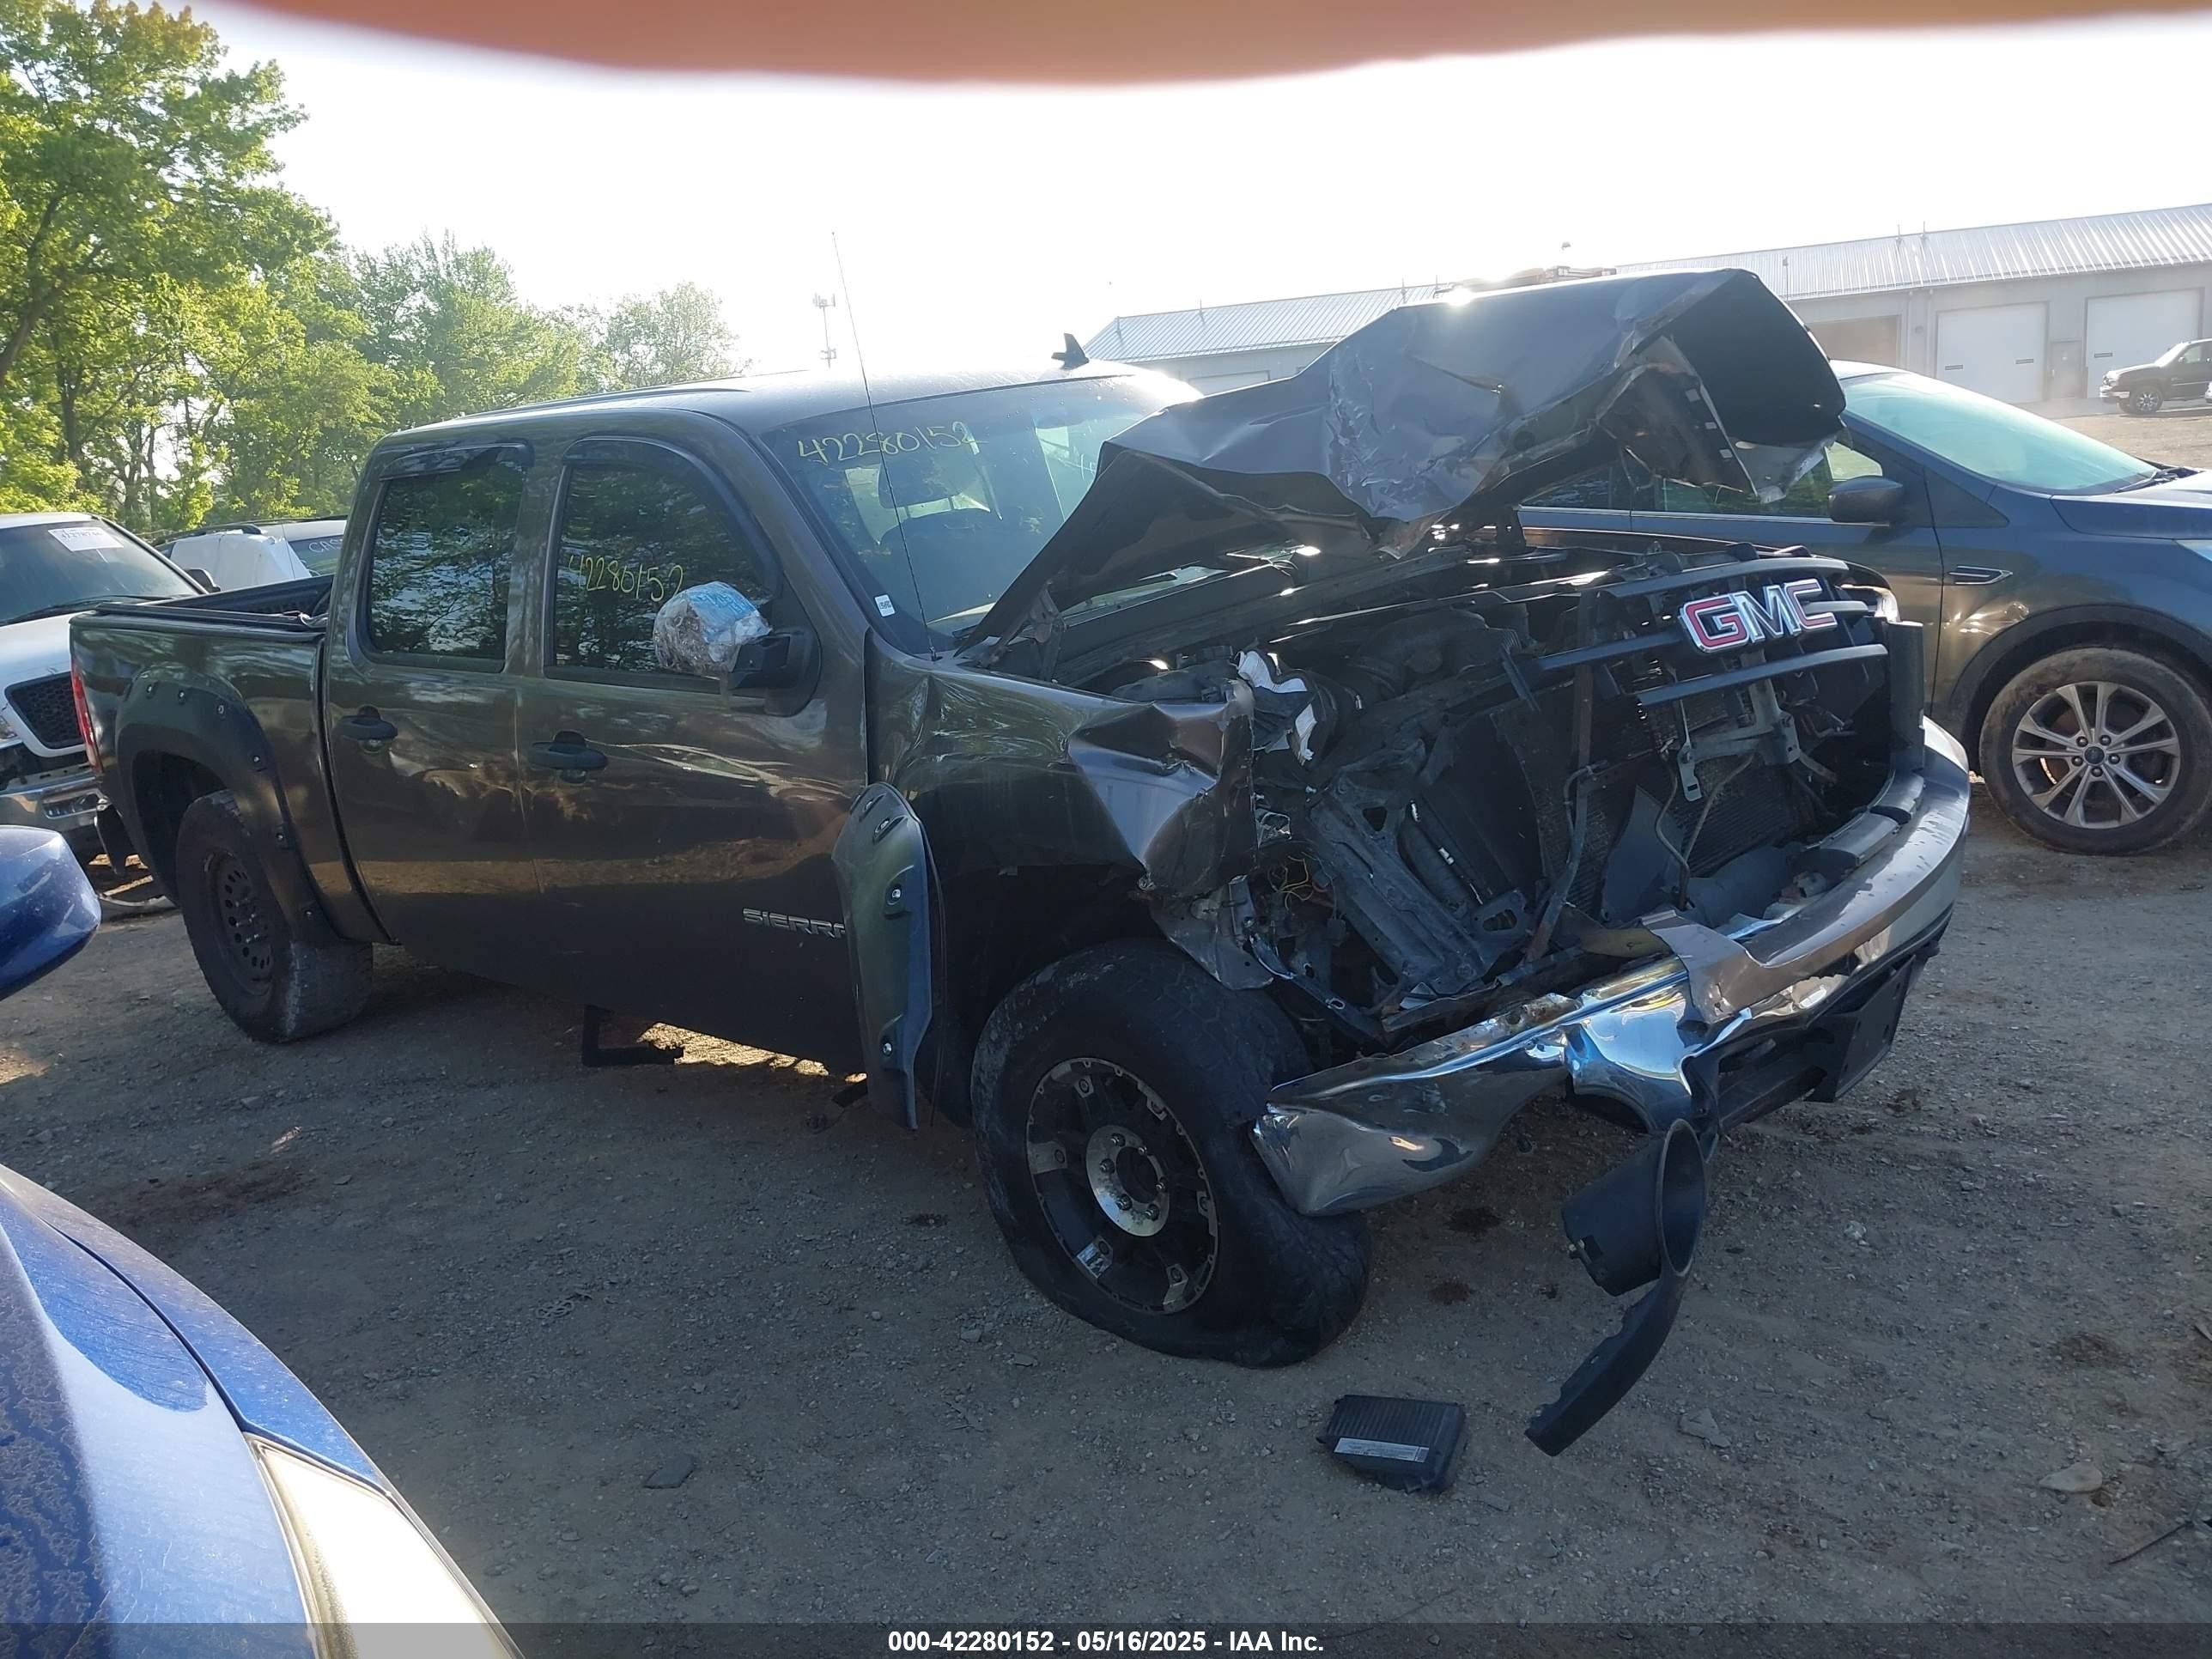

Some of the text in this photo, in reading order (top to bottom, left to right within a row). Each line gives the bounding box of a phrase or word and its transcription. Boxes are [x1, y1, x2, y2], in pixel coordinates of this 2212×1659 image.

[797, 421, 984, 465] 42280152
[568, 554, 684, 603] 42280152
[1678, 578, 1838, 653] GMC
